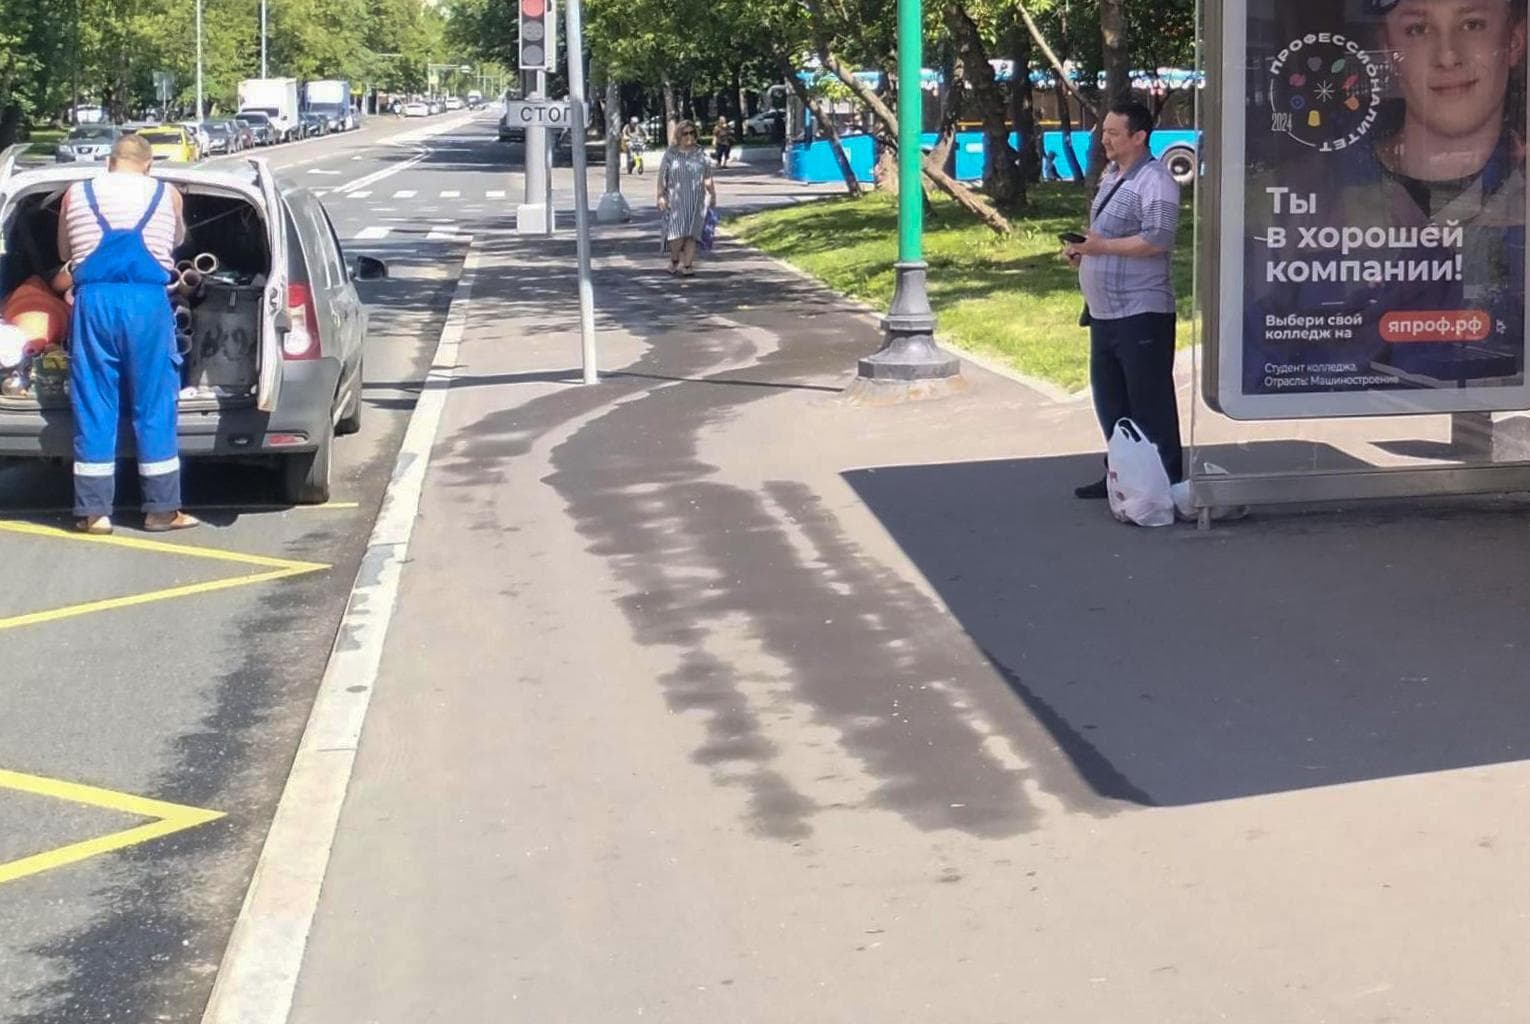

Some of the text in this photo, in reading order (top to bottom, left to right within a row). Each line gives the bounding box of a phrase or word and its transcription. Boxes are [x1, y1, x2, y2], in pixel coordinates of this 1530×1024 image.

[1270, 32, 1381, 152] ПРОФЕССИОНАЛИТЕТ
[1271, 112, 1292, 132] 2024
[1266, 186, 1316, 214] Ты
[1267, 219, 1463, 255] в хорошей
[1266, 254, 1463, 282] компании!
[1265, 312, 1362, 328] Выбери свой
[1388, 316, 1482, 336] япроф.рф
[1265, 329, 1353, 340] колледж на
[1264, 362, 1305, 375] Студент
